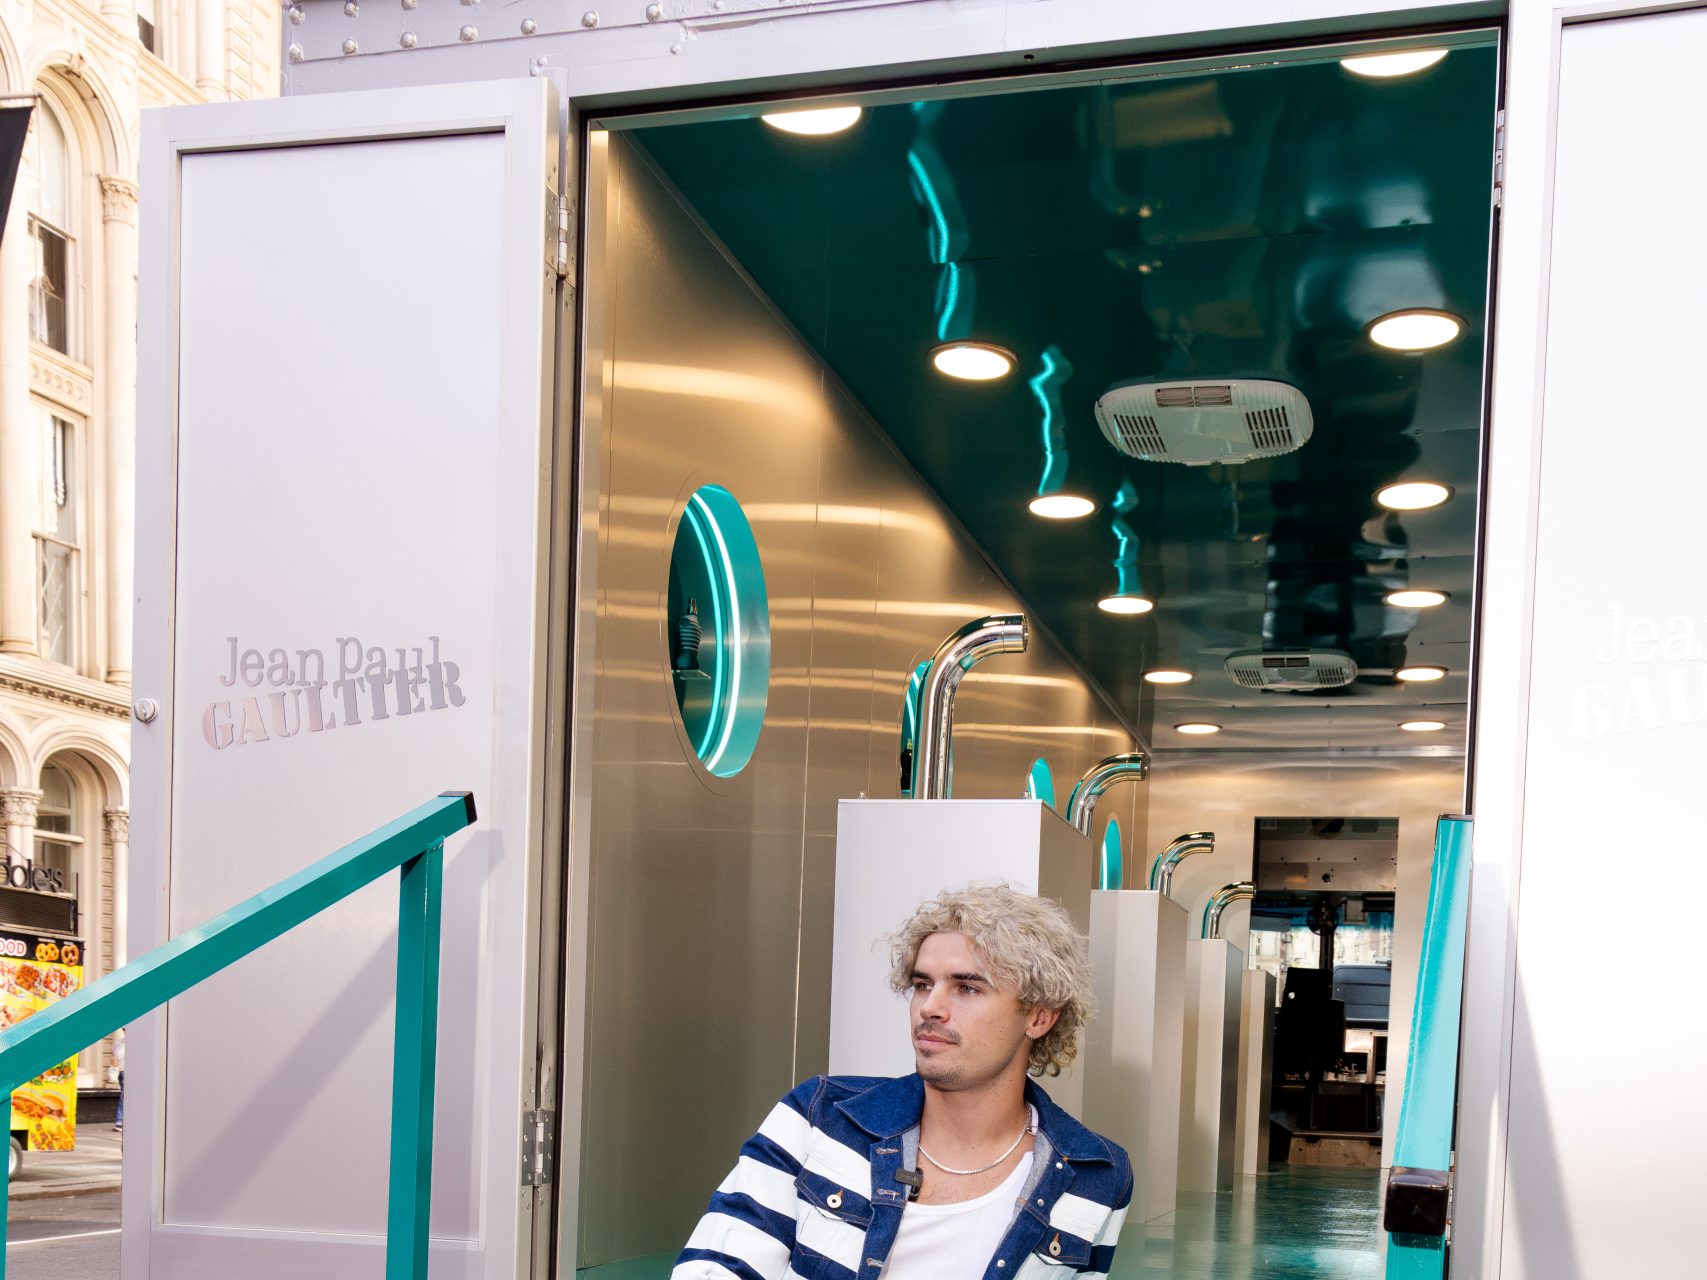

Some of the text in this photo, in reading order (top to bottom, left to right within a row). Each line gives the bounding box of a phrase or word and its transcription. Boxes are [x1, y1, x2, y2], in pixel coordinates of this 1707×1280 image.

[218, 636, 328, 687] Jean
[1594, 603, 1707, 664] Jea
[202, 660, 467, 750] GAULTIER
